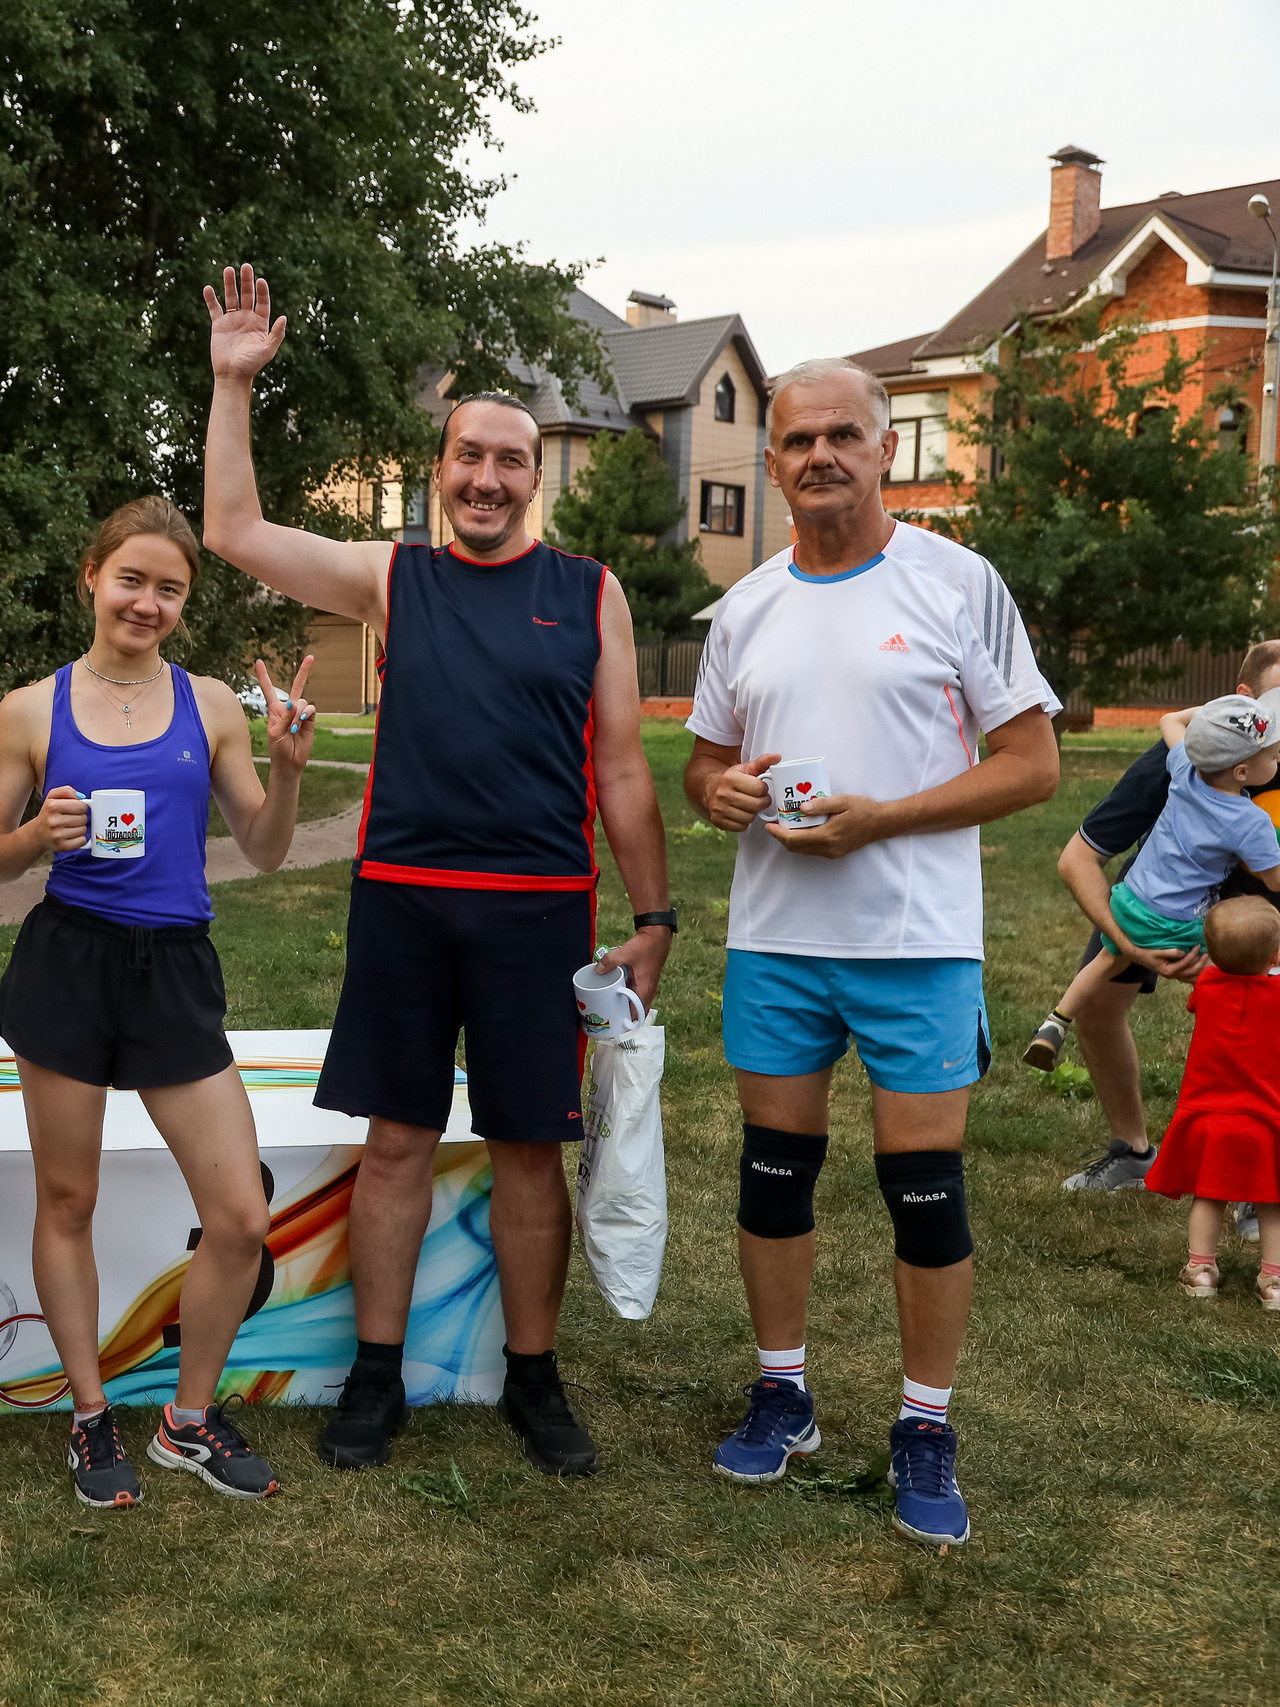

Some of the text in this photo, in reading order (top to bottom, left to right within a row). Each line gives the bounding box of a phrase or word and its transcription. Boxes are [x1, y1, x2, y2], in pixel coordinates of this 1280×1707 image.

[879, 643, 910, 652] adidas
[784, 786, 795, 799] Я
[107, 816, 118, 828] Я
